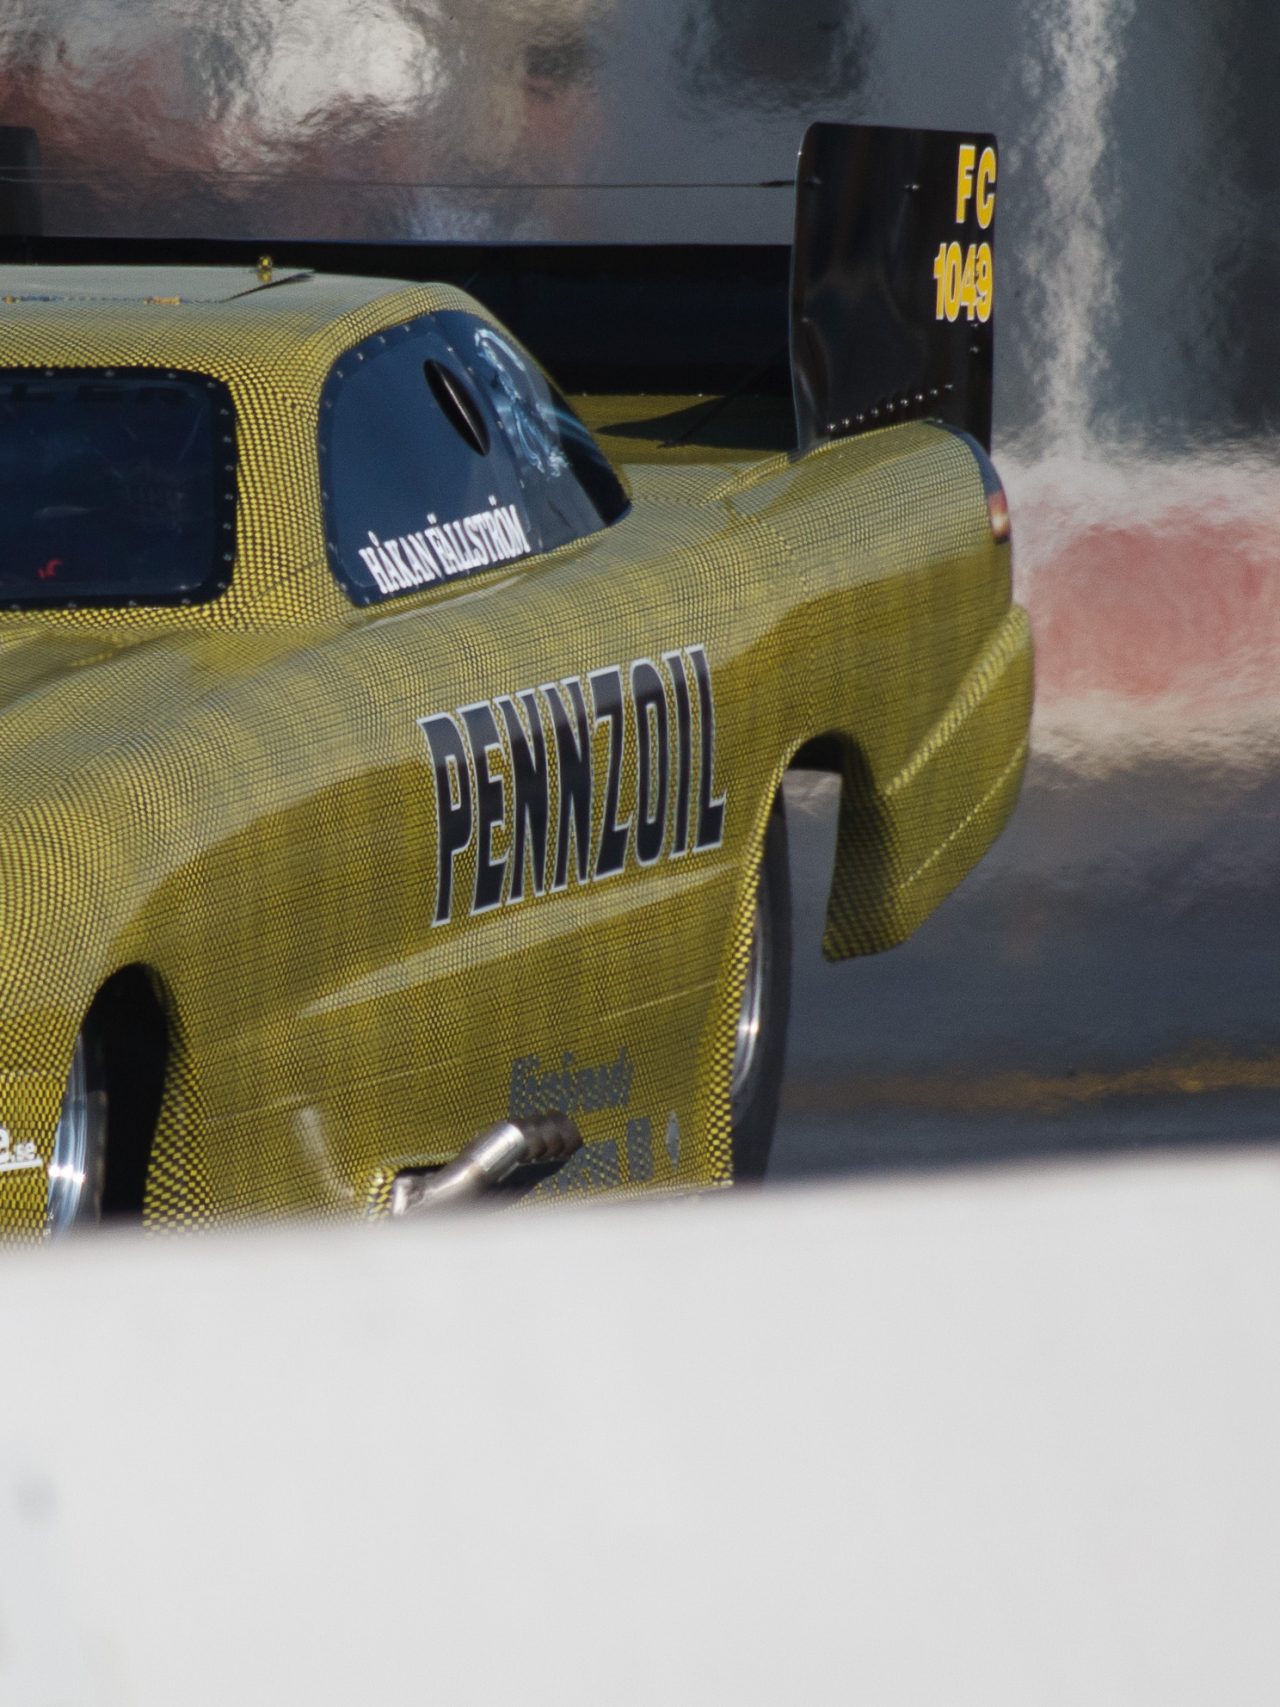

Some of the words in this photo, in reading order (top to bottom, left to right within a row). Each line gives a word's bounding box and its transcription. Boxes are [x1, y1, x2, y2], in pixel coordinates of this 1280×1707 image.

[955, 144, 996, 229] FC
[933, 241, 993, 322] 1049
[358, 529, 443, 594] HÅKAN
[416, 644, 726, 928] PENNZOIL
